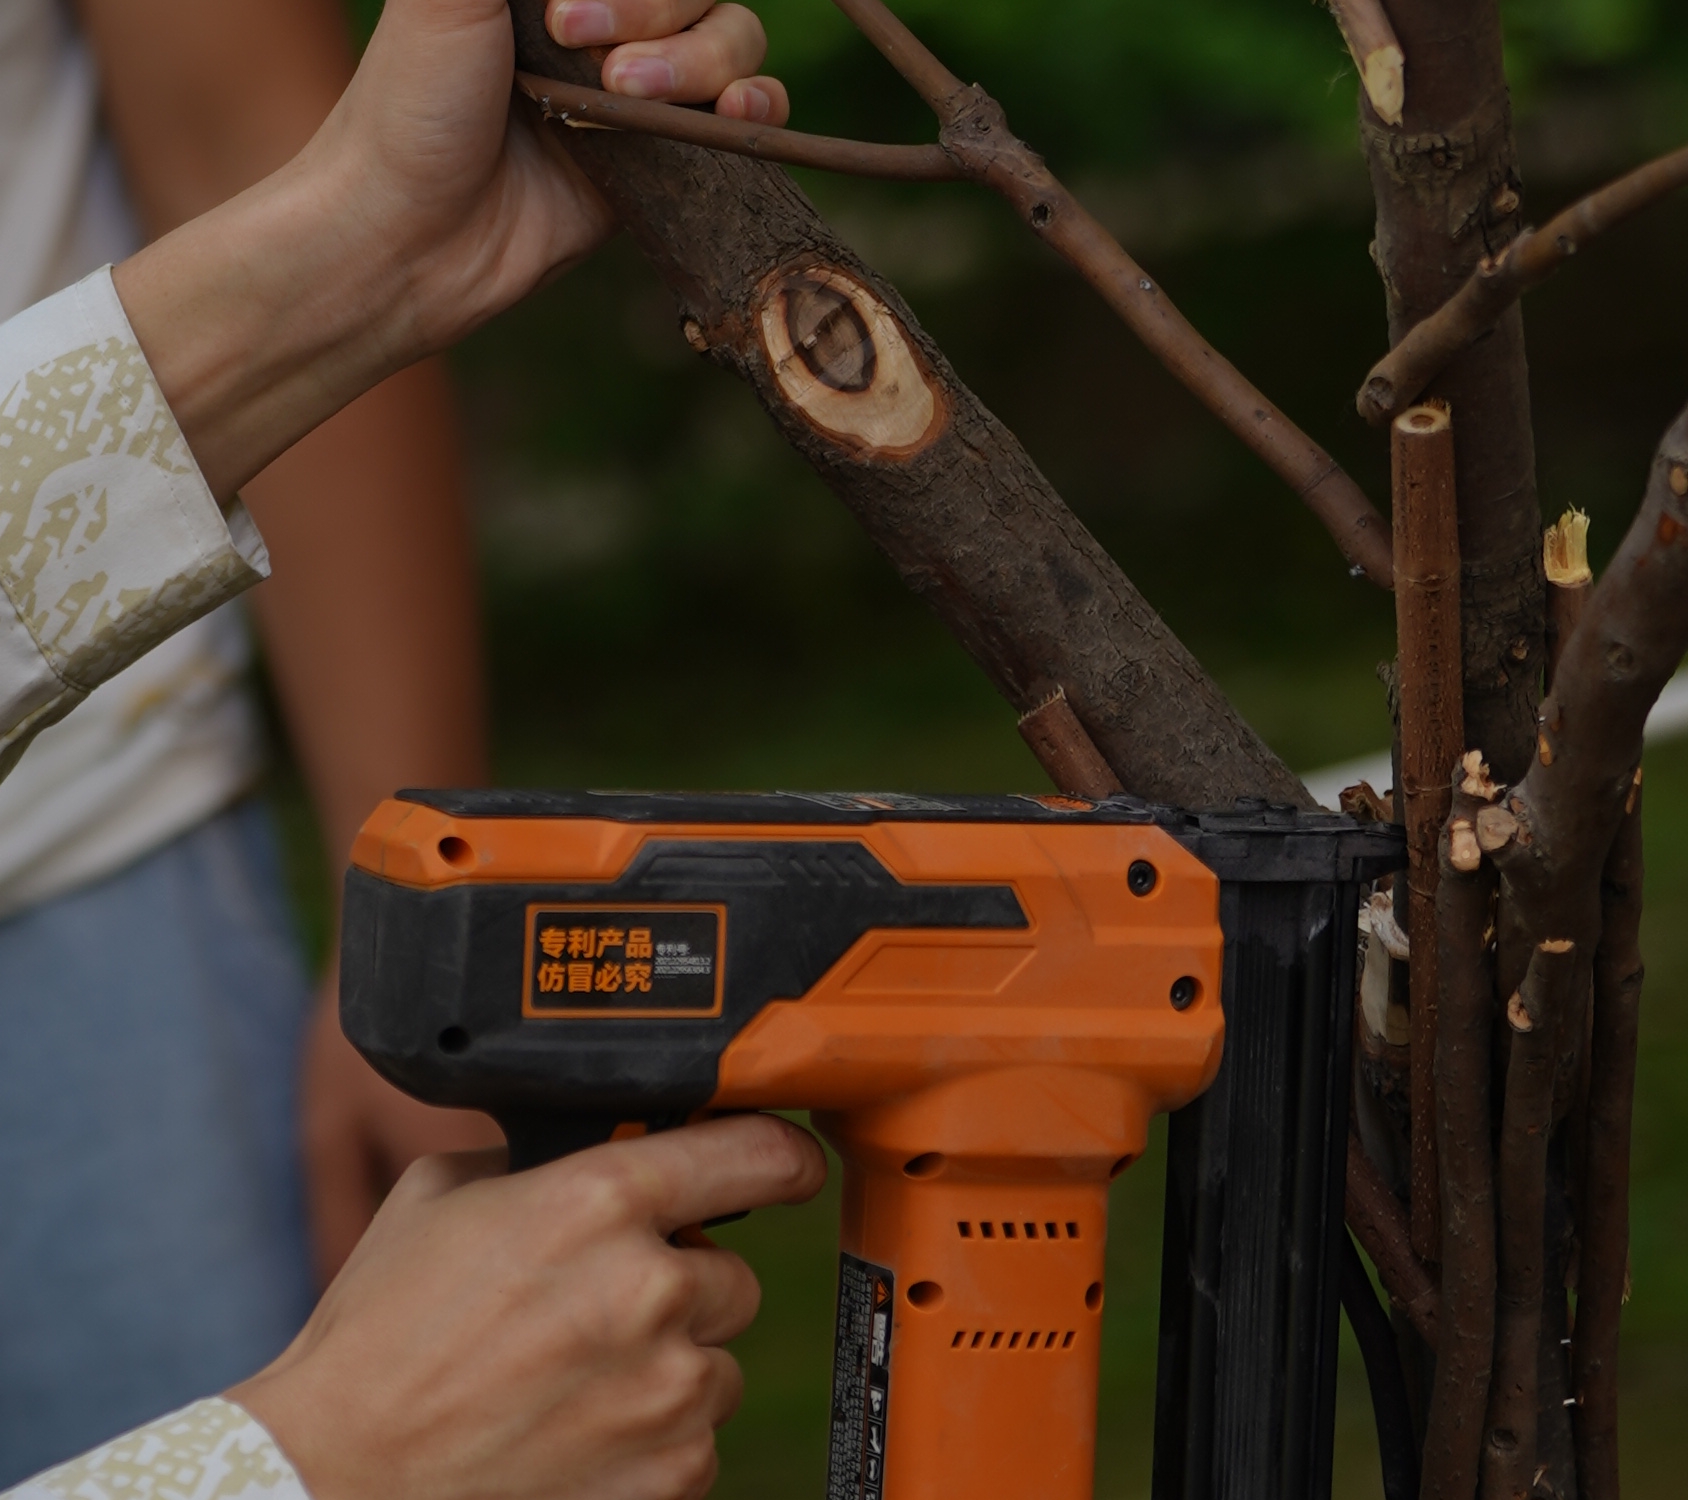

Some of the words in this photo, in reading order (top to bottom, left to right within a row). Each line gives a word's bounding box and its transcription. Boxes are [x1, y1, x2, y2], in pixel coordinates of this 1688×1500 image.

[538, 926, 653, 960] 专利产品
[536, 961, 653, 994] 仿冒必究
